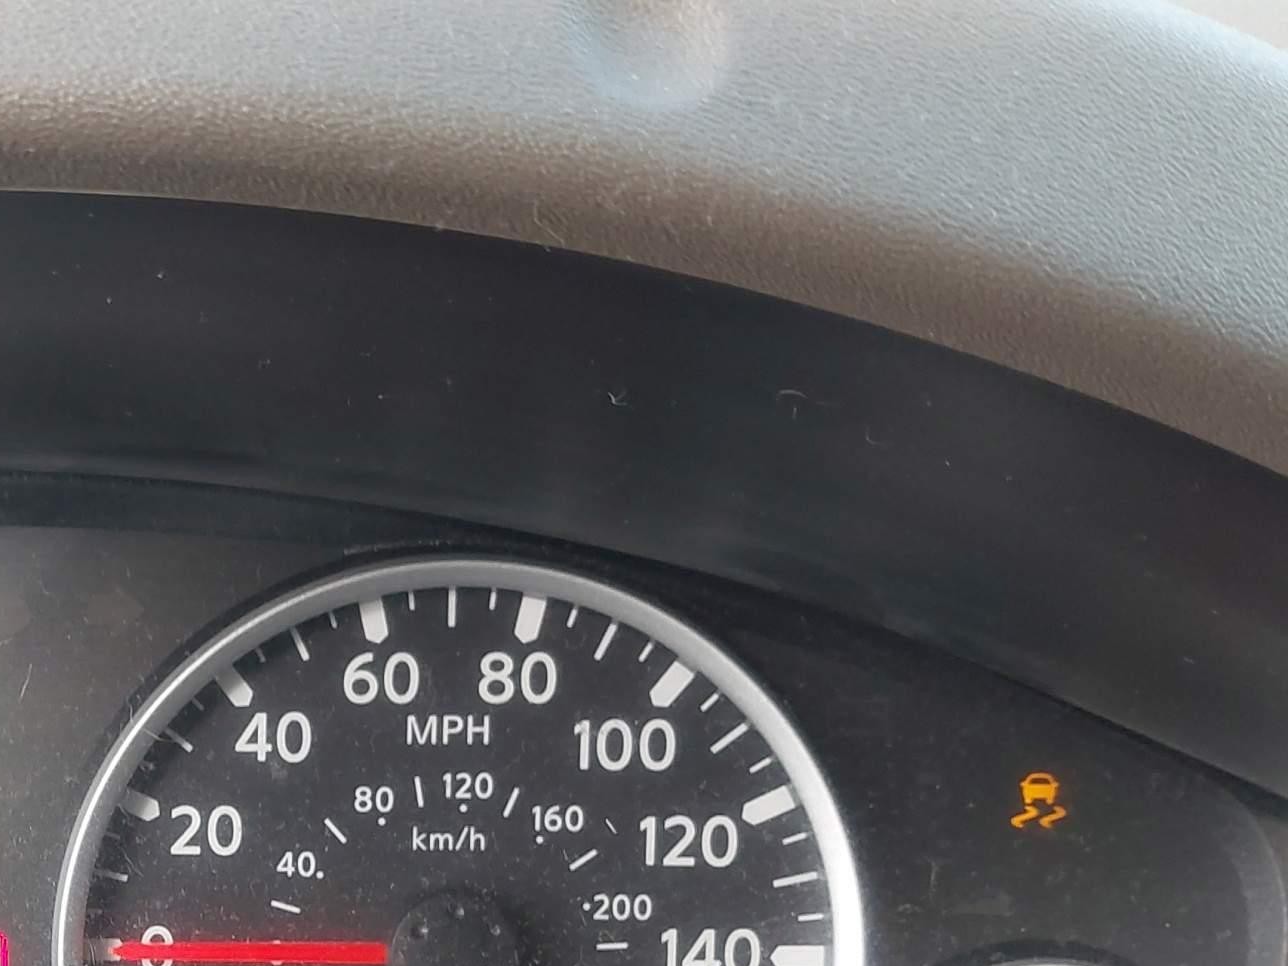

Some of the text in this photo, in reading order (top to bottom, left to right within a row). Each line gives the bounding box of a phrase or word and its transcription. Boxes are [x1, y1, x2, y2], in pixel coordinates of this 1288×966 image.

[344, 653, 419, 704] 60
[479, 652, 556, 704] 80
[235, 712, 311, 762] 40
[407, 715, 489, 744] MPH
[574, 719, 675, 771] 100
[355, 787, 393, 812] 80
[443, 773, 493, 799] 120
[171, 805, 242, 856] 20
[533, 806, 583, 831] 160
[412, 826, 486, 852] km/h
[640, 816, 738, 867] 120
[277, 852, 314, 877] 40
[593, 894, 652, 920] 200
